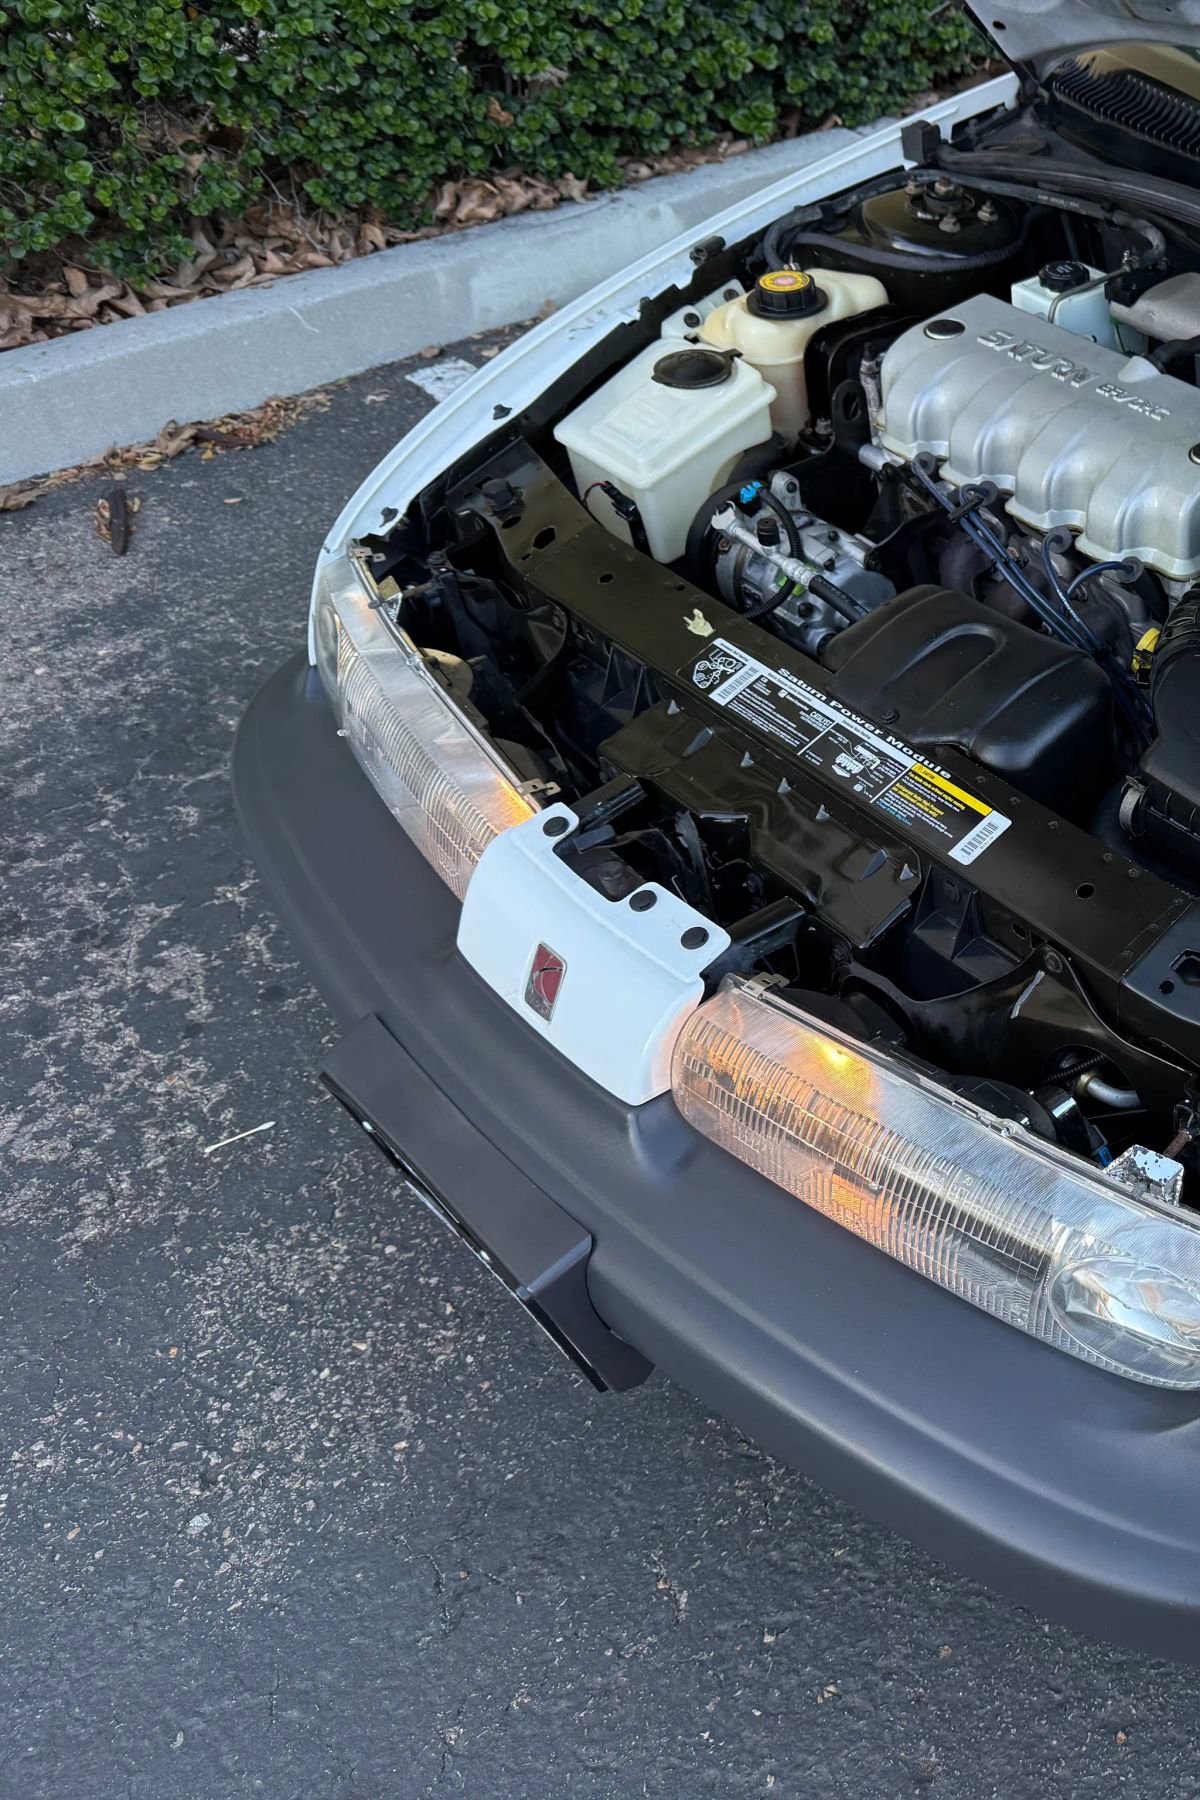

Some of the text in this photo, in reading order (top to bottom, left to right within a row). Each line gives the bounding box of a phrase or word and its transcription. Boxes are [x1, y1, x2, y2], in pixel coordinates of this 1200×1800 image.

[976, 329, 1099, 389] SATURN
[777, 667, 828, 702] Saturn
[829, 700, 884, 736] Power
[885, 735, 952, 780] Module
[810, 711, 832, 726] CATALYST
